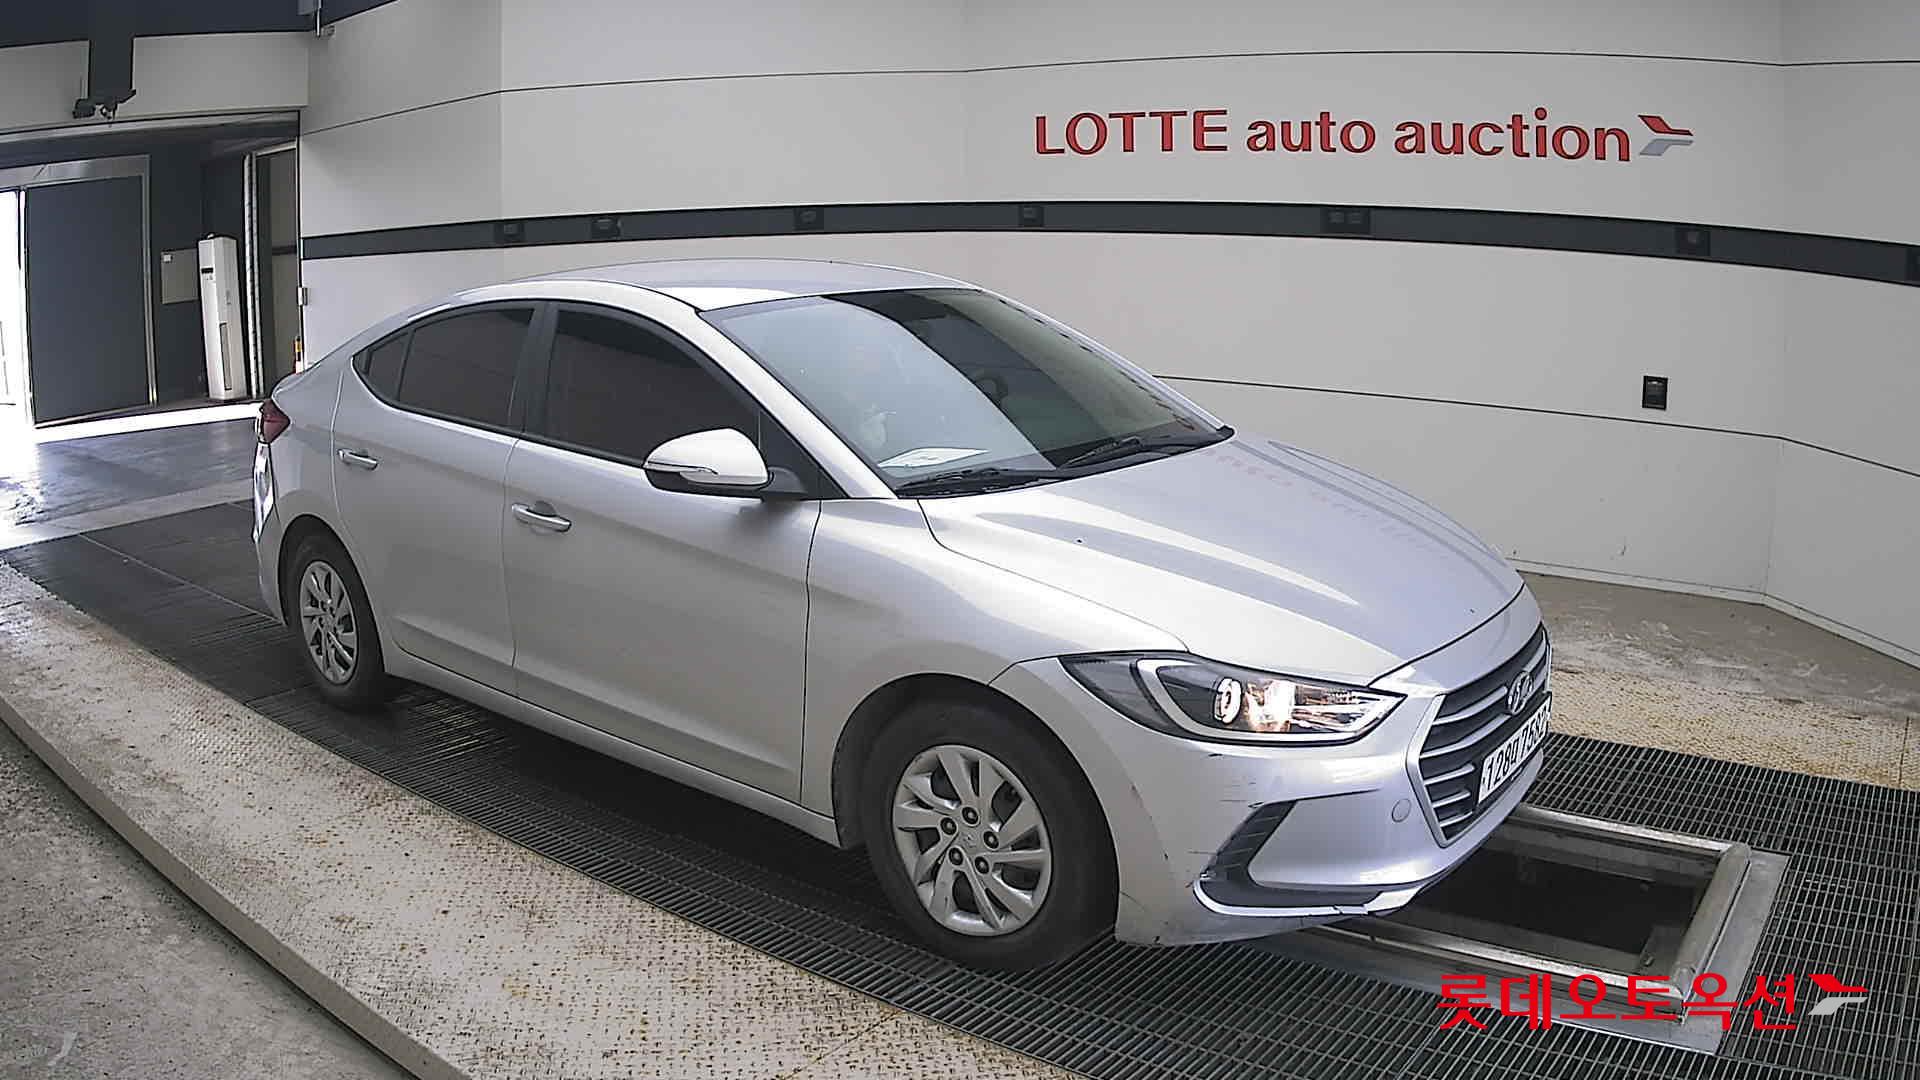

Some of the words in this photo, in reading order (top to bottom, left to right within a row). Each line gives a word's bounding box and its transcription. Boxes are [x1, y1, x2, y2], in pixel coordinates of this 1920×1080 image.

[1035, 109, 1227, 156] LOTTE
[1246, 110, 1376, 153] auto
[1394, 106, 1632, 162] auction
